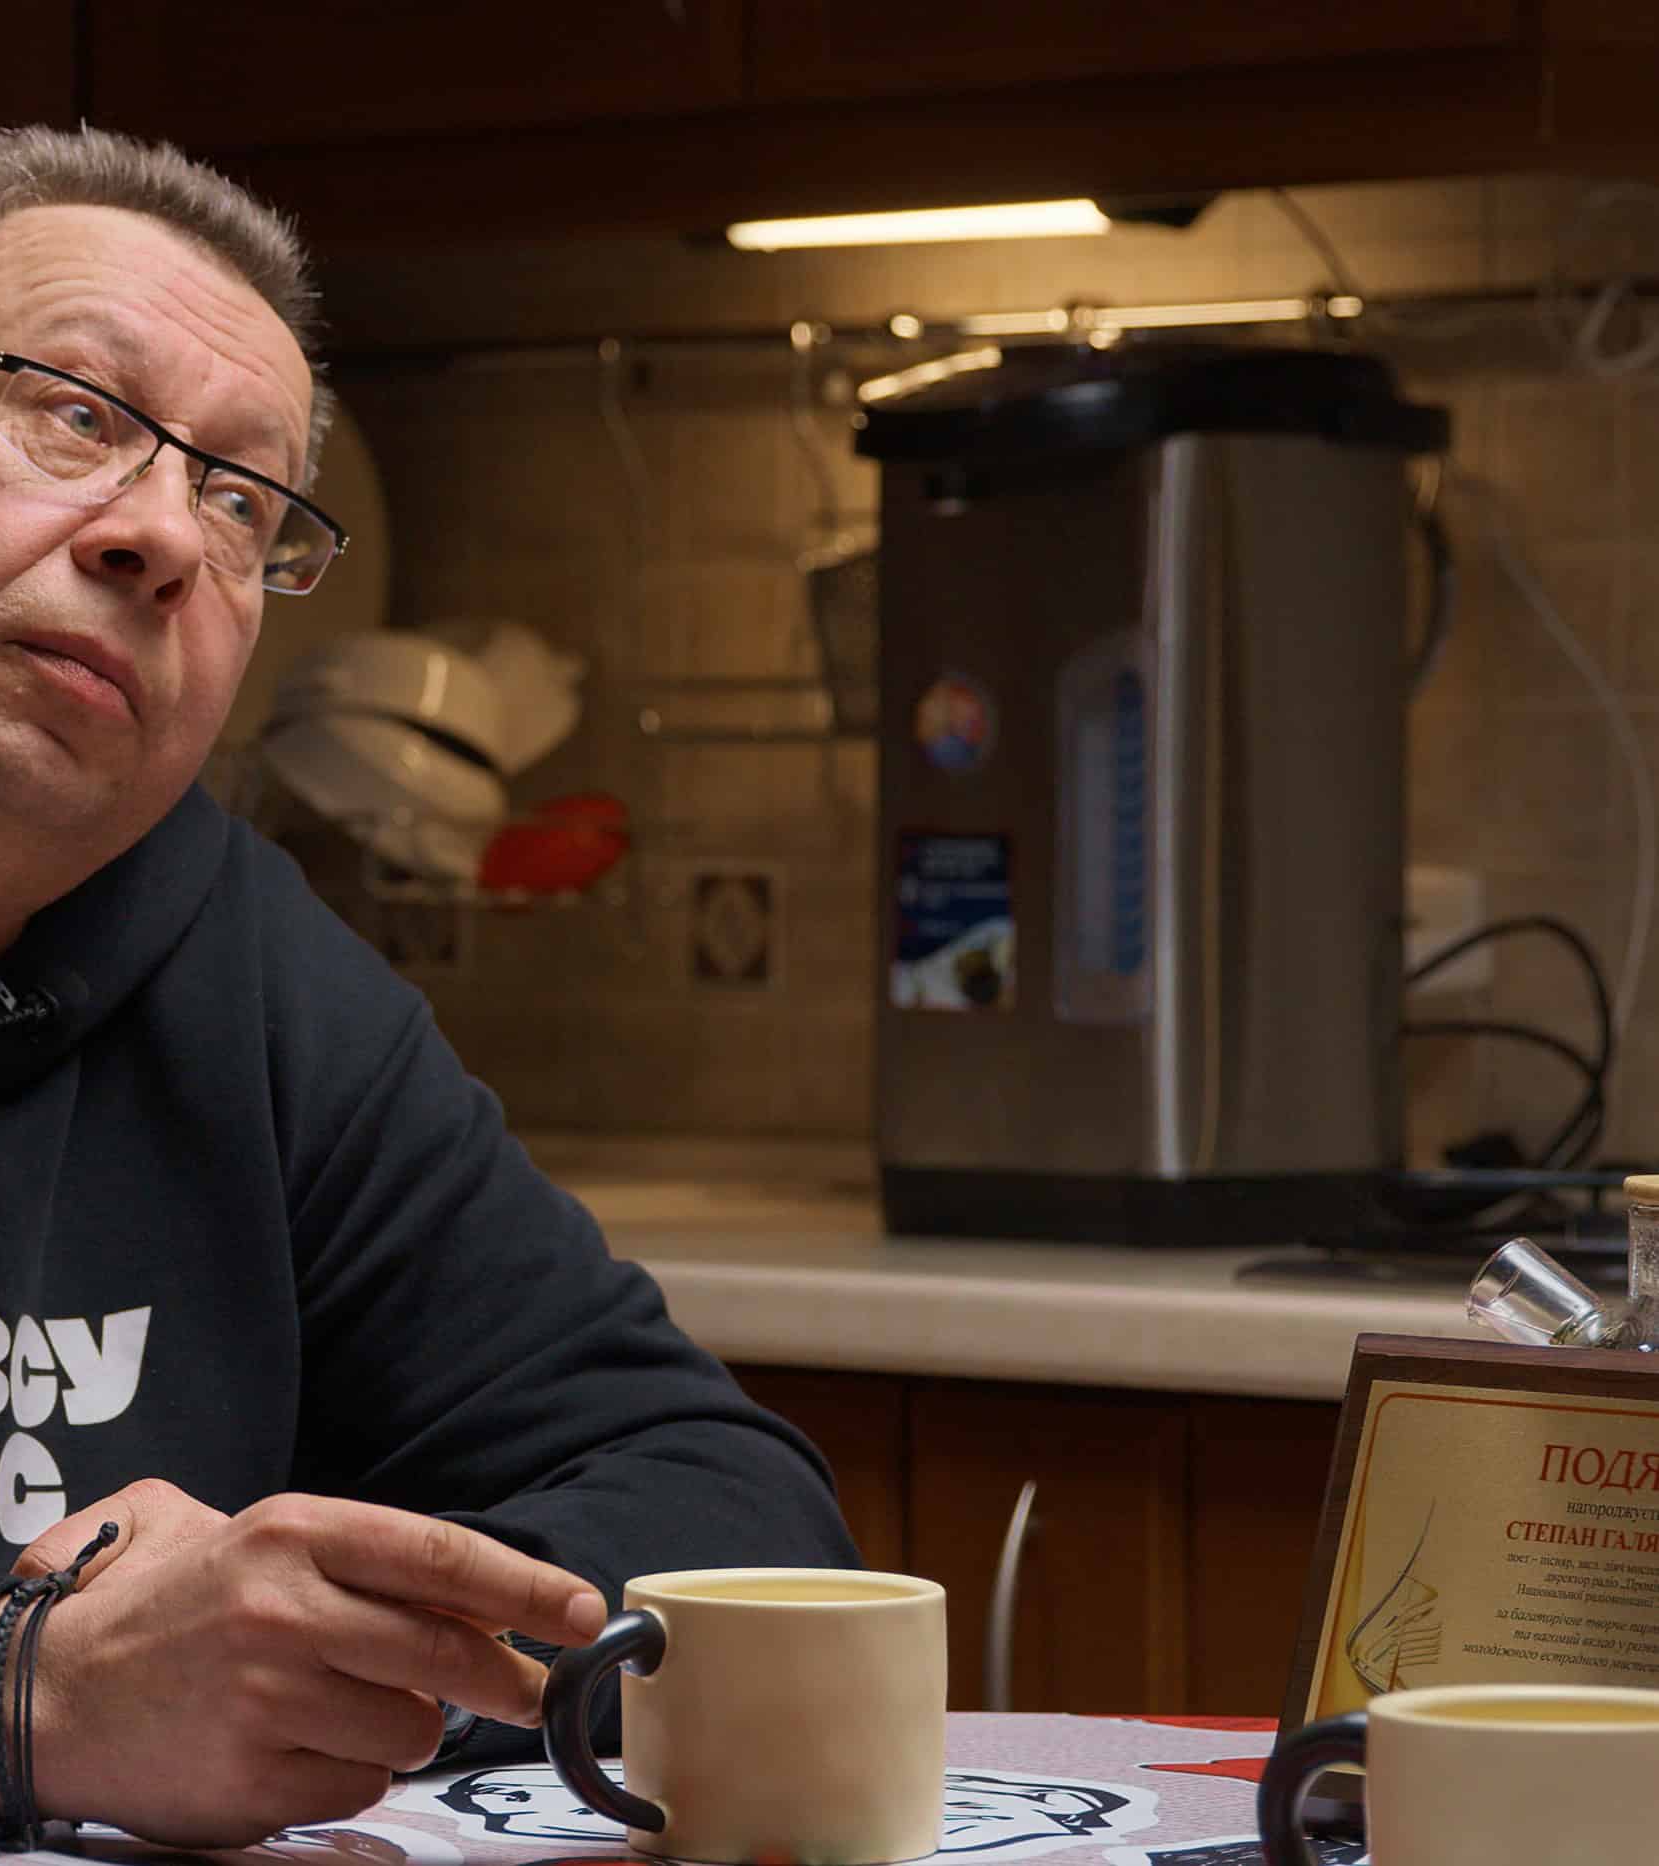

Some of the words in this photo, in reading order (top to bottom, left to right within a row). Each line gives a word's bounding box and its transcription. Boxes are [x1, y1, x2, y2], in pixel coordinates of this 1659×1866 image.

[1538, 1443, 1659, 1496] ПОДЯ
[1506, 1520, 1597, 1548] СТЕПАН
[1600, 1528, 1659, 1553] ГАЛЯ
